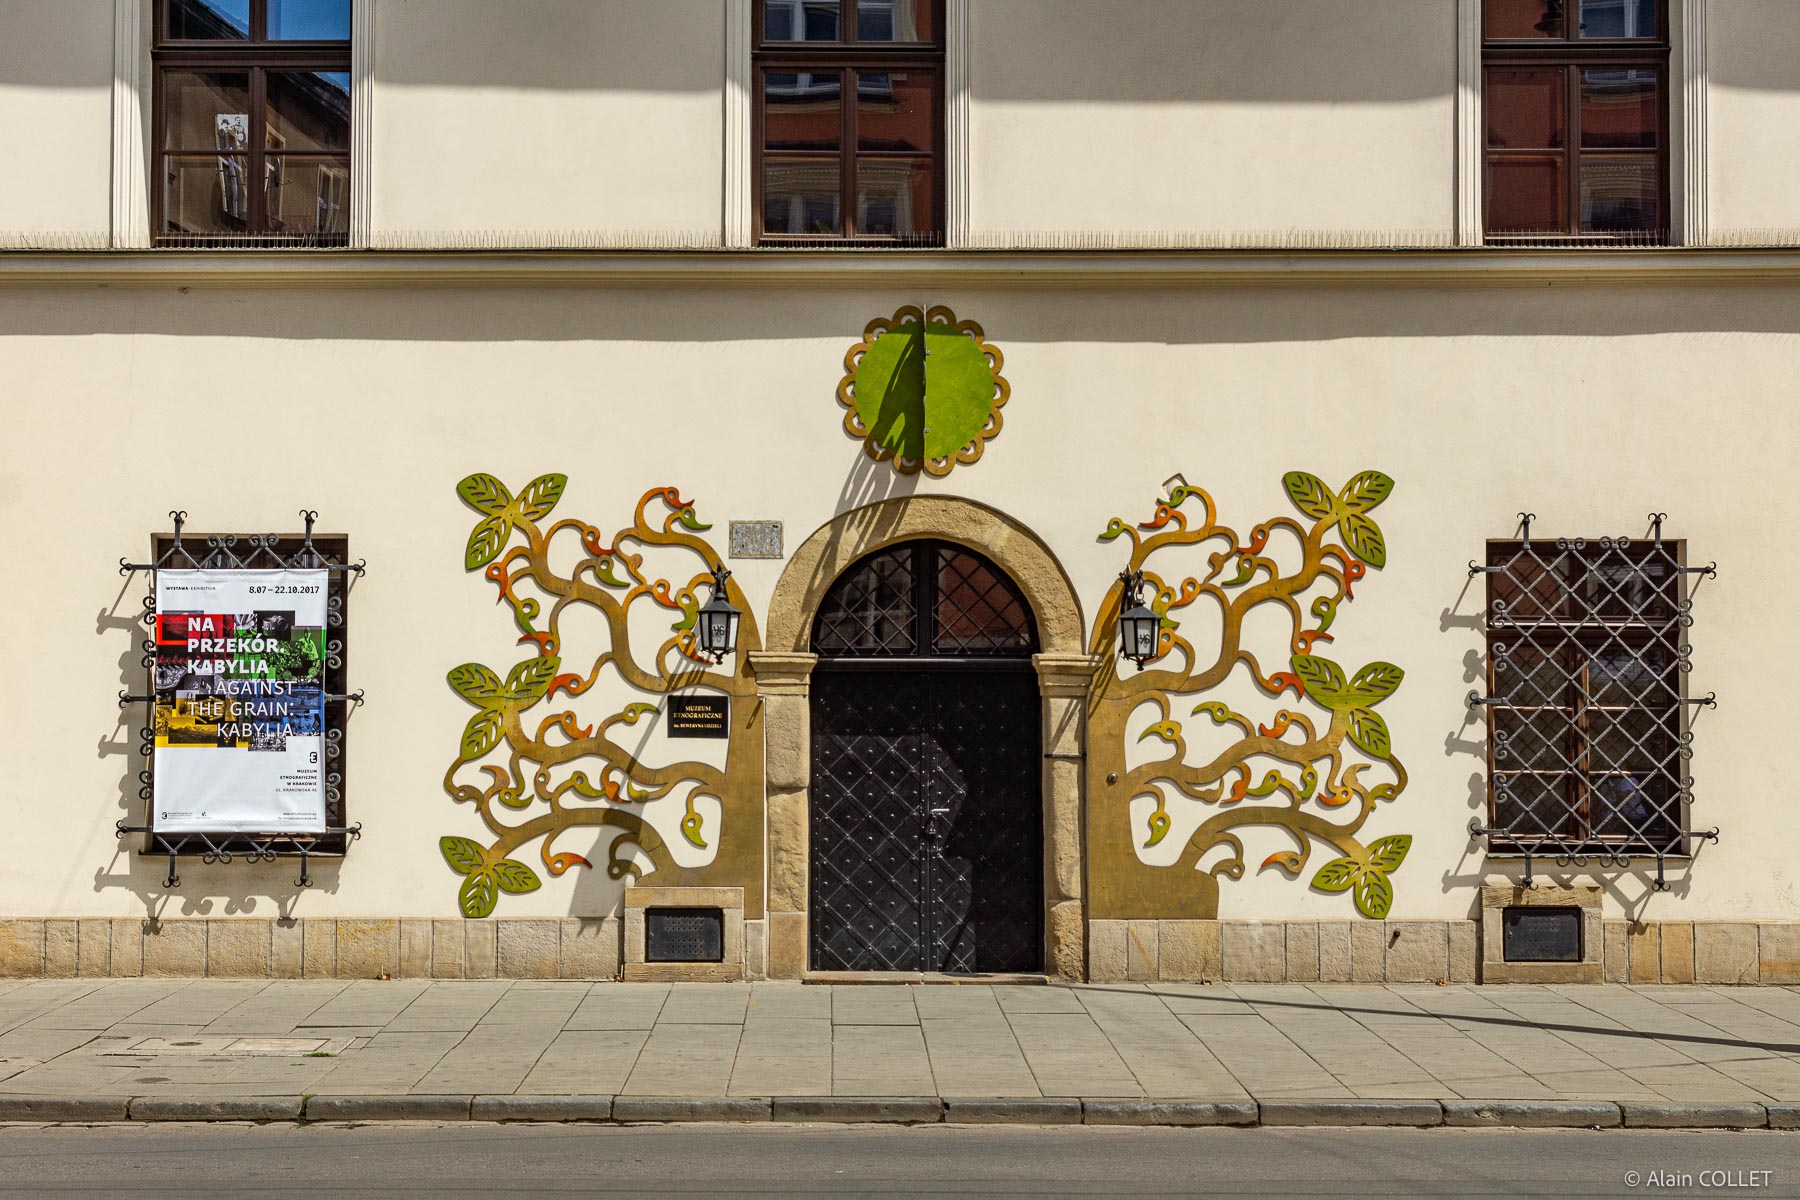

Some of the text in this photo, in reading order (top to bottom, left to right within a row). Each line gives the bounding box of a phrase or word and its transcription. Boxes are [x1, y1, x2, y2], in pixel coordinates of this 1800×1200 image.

[187, 617, 215, 632] NA
[187, 633, 285, 653] PRZEKÓR.
[187, 659, 270, 674] KABYLIA
[214, 681, 298, 695] AGAINST
[187, 702, 295, 717] THE GRAIN:
[216, 723, 295, 738] KABYLIA
